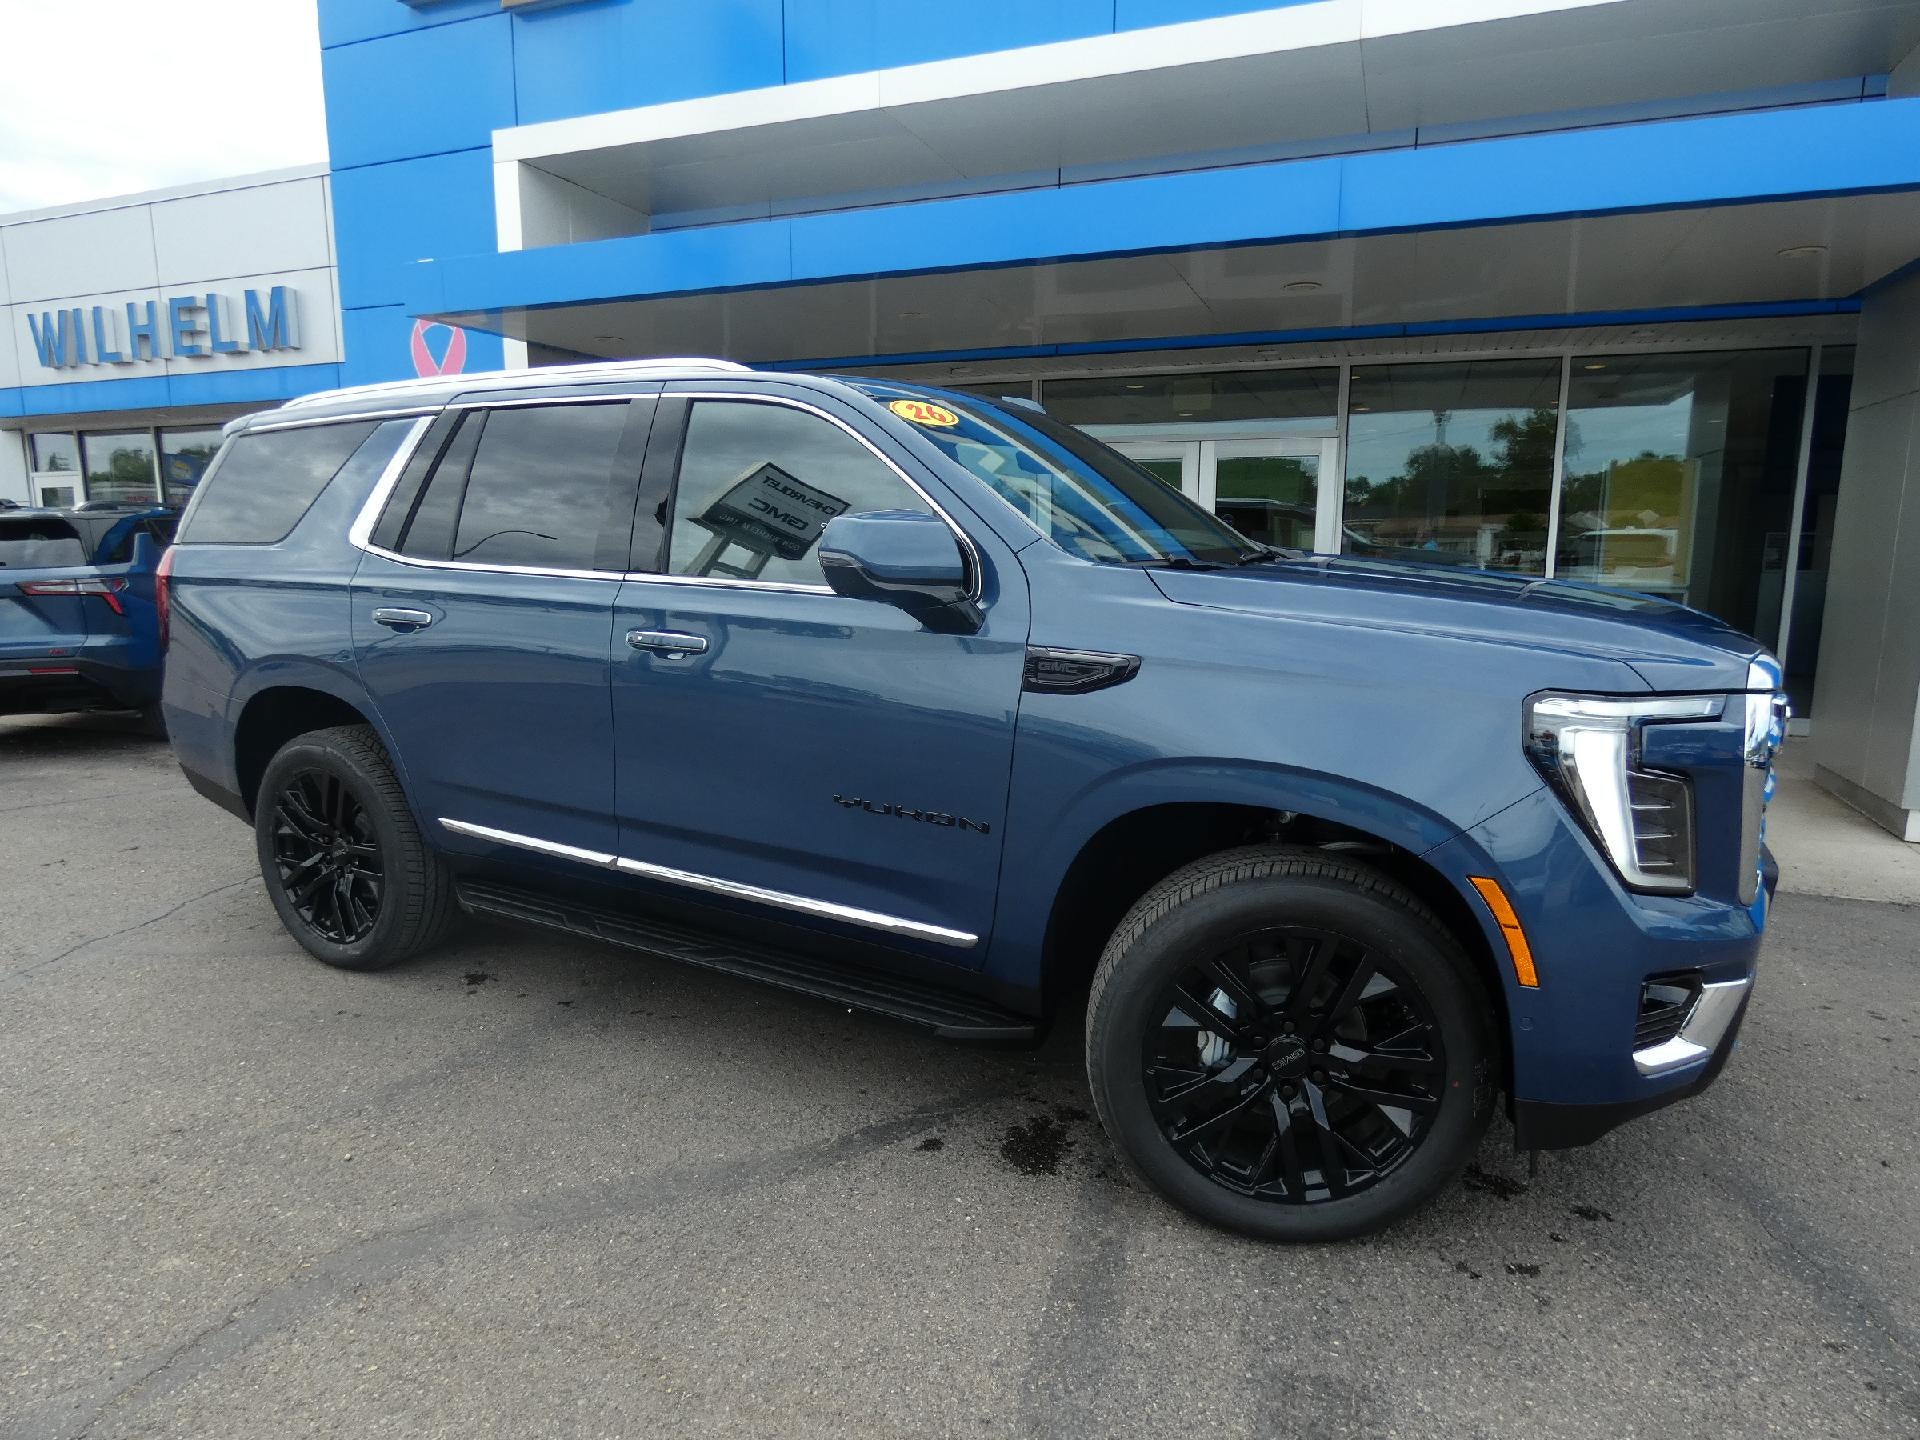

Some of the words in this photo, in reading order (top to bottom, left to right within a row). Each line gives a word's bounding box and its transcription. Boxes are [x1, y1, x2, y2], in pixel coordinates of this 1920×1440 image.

[27, 285, 300, 369] WILHELM
[905, 403, 947, 423] 26
[832, 793, 991, 835] YUKON
